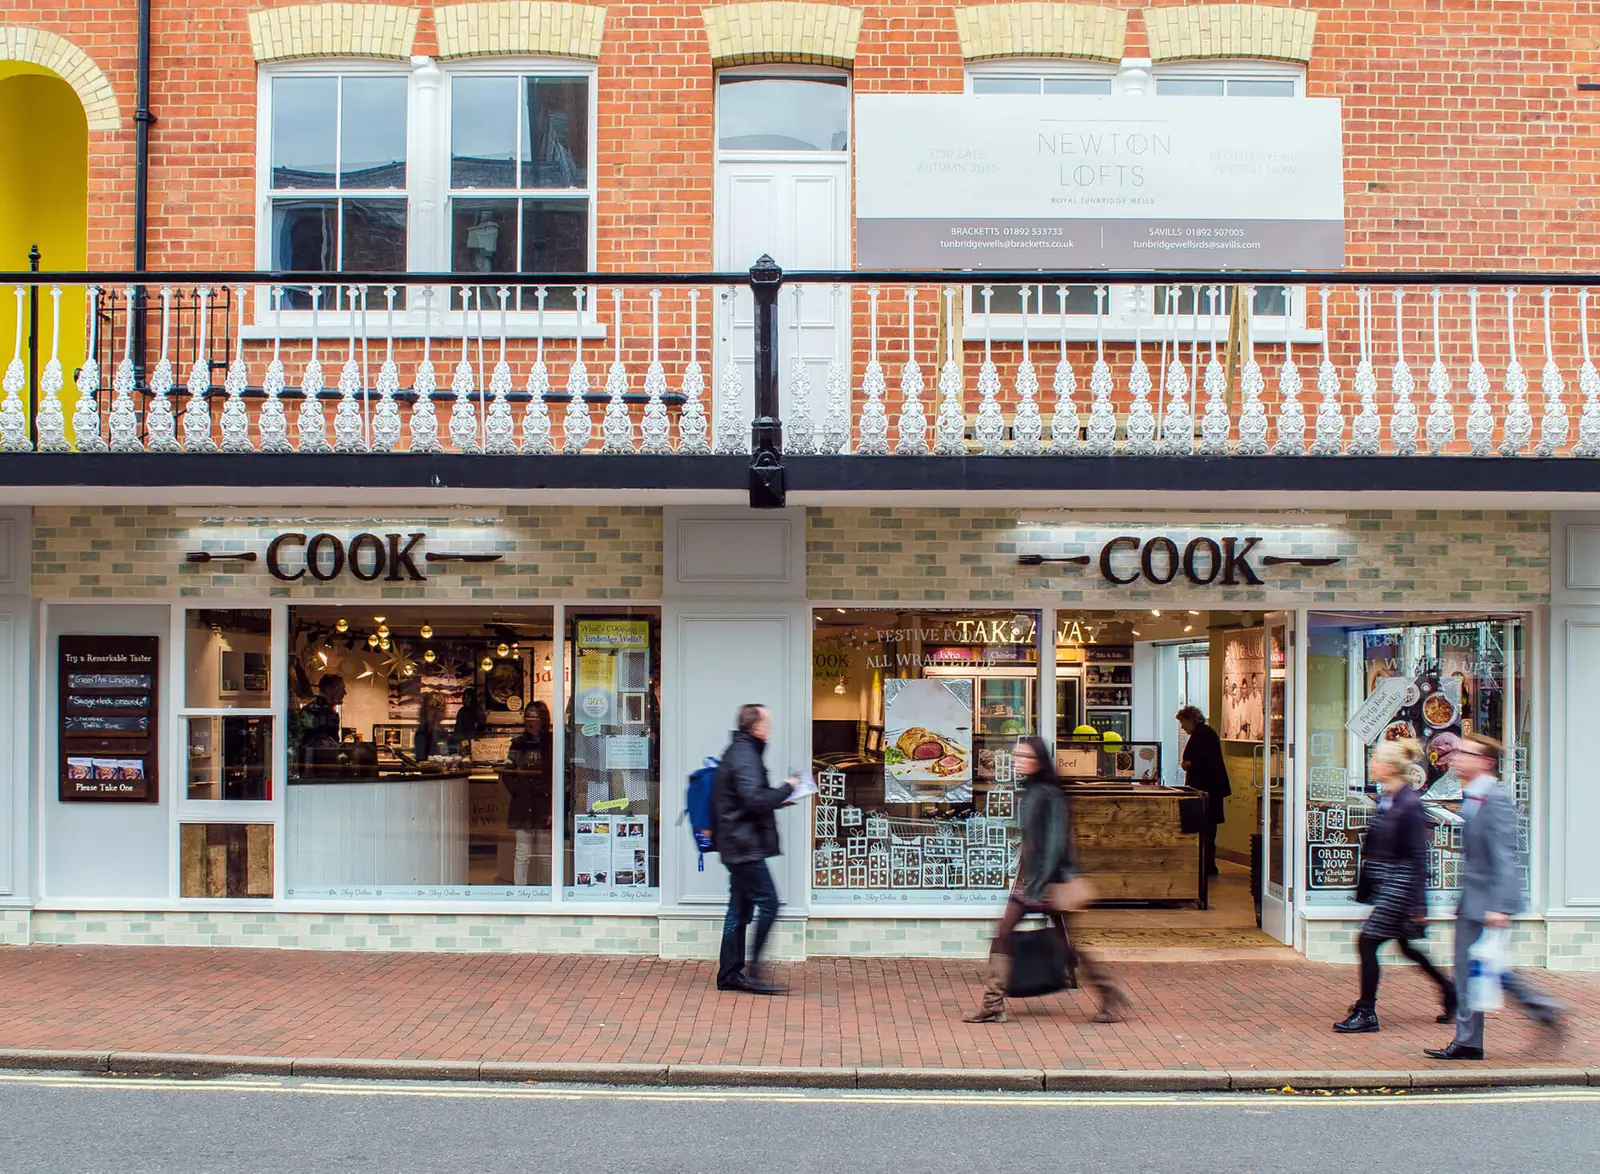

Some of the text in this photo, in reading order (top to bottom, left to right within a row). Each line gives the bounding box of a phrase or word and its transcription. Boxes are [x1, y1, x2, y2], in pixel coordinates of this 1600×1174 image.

[1038, 132, 1172, 156] NEWTON
[929, 148, 954, 160] FOR
[916, 162, 1000, 174] AUTUMN 2015
[1060, 164, 1144, 187] LOFTS
[1130, 197, 1155, 205] WELLS
[951, 227, 1063, 236] BRACKETTS 01892 533733
[1148, 228, 1244, 237] SAVILLS 01892 507005
[940, 239, 1074, 250] tunbridgewells@bracketts.co.uk
[1133, 240, 1261, 250] tunbridgewellsrds@savills.com
[266, 532, 427, 581] COOK
[1099, 536, 1266, 586] COOK
[876, 628, 940, 643] FESTIVE
[65, 653, 77, 664] Try
[87, 653, 127, 663] Remarkable
[129, 653, 152, 663] Taster
[866, 656, 892, 669] ALL
[1359, 705, 1378, 723] Party
[1058, 758, 1077, 767] Beef
[76, 783, 134, 792] Please Take One
[1318, 849, 1353, 859] ORDER
[1323, 859, 1348, 868] NOW
[340, 887, 353, 897] Shop
[429, 888, 443, 897] Shop
[517, 889, 532, 898] Shop
[620, 891, 634, 899] Shop
[865, 893, 879, 902] Shop
[954, 893, 969, 902] Shop
